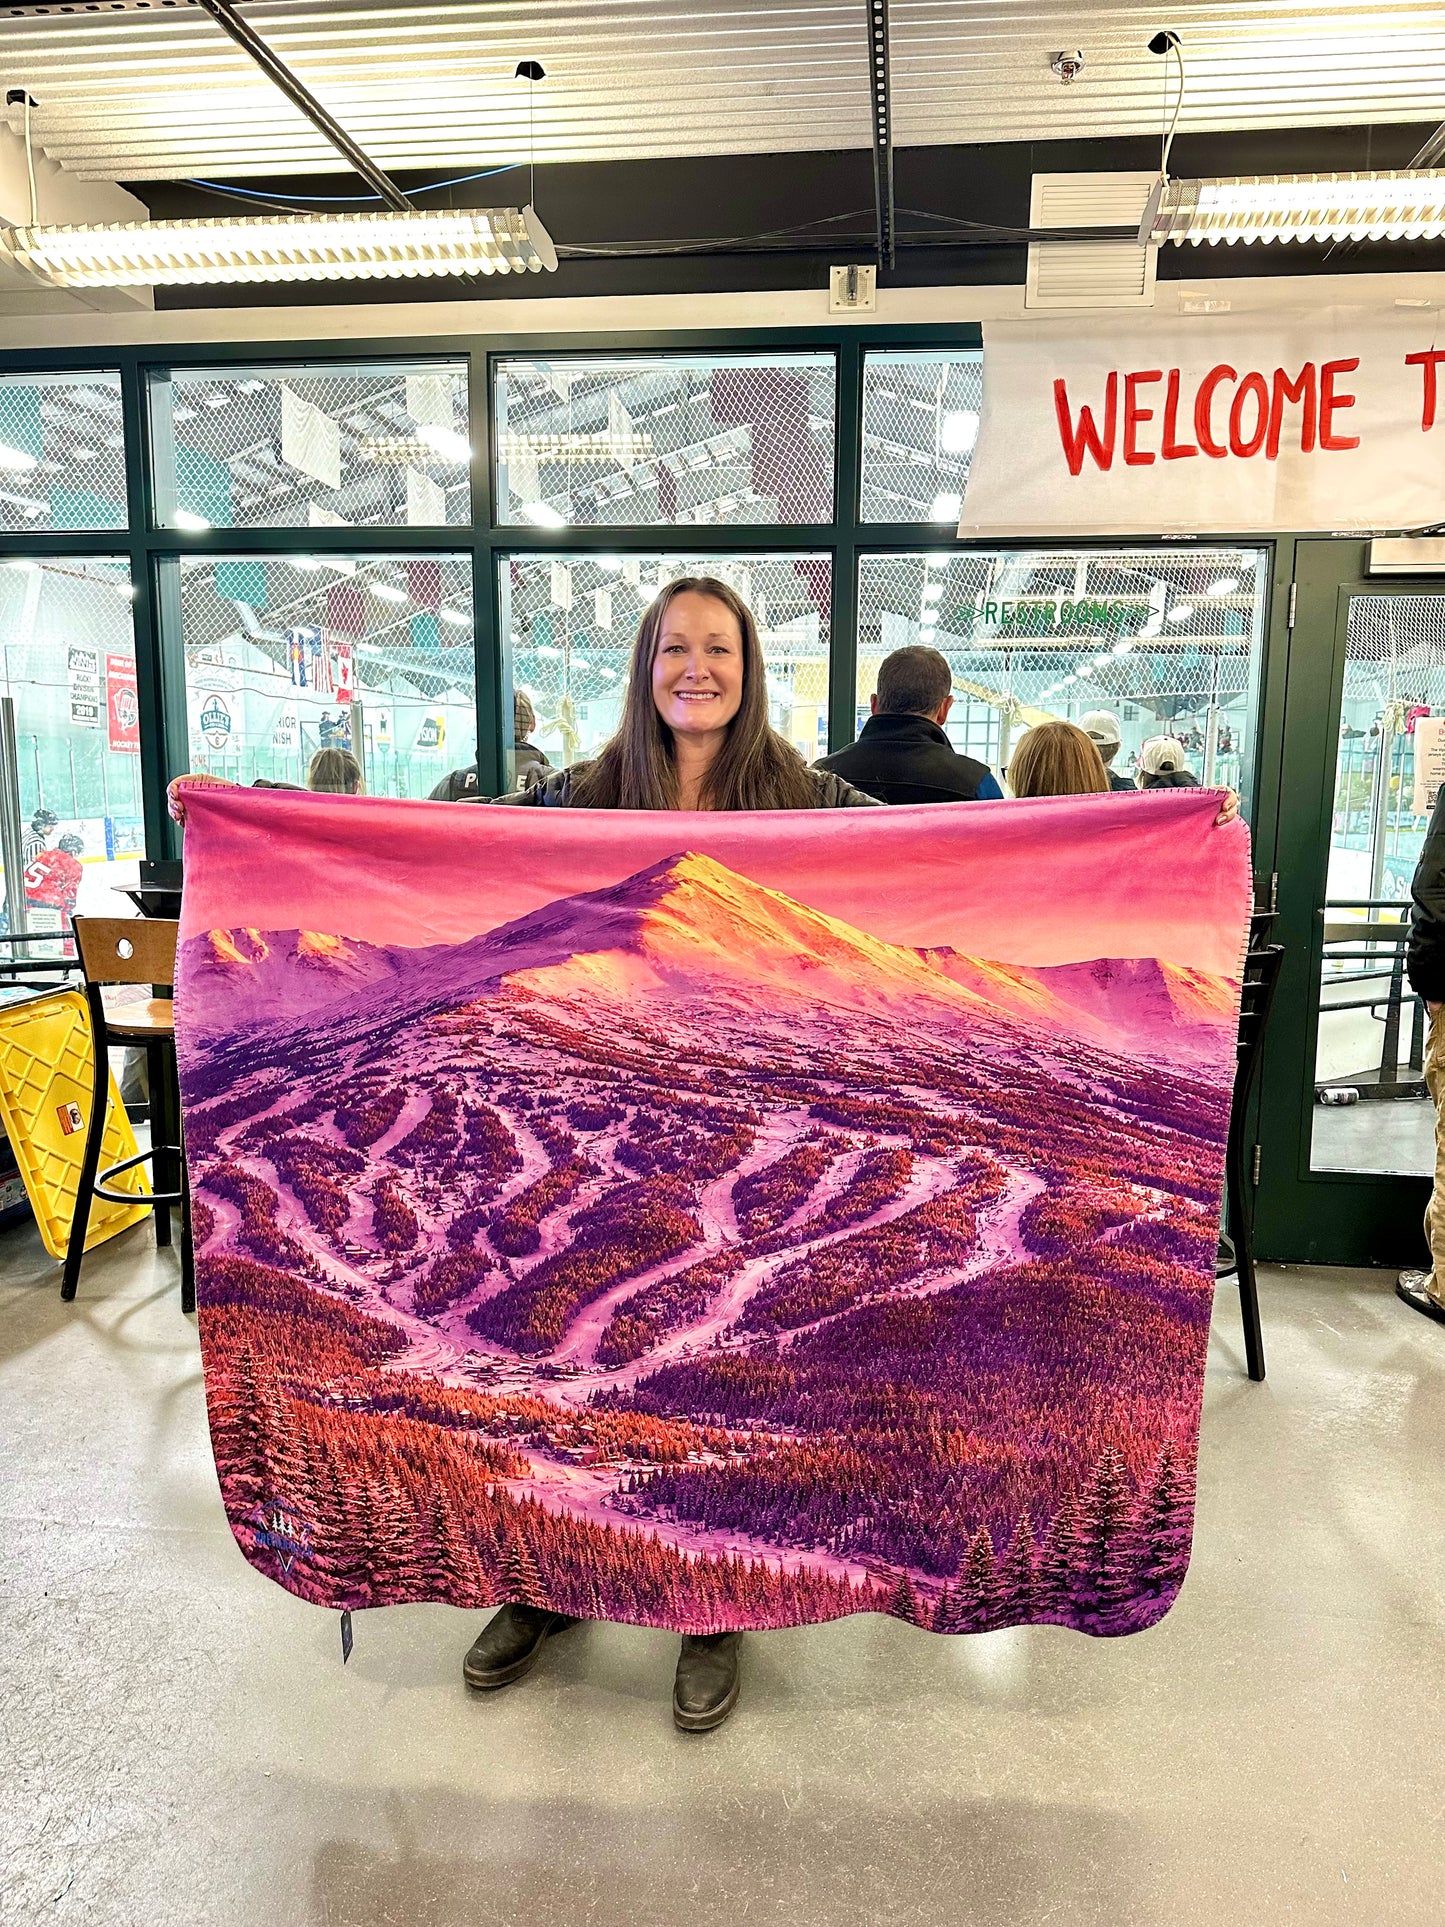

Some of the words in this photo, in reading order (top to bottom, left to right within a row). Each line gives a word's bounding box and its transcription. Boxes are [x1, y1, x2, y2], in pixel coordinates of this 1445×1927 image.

[1053, 357, 1361, 477] WELCOME
[985, 600, 1124, 625] RESTROOMS
[75, 705, 94, 717] 2019
